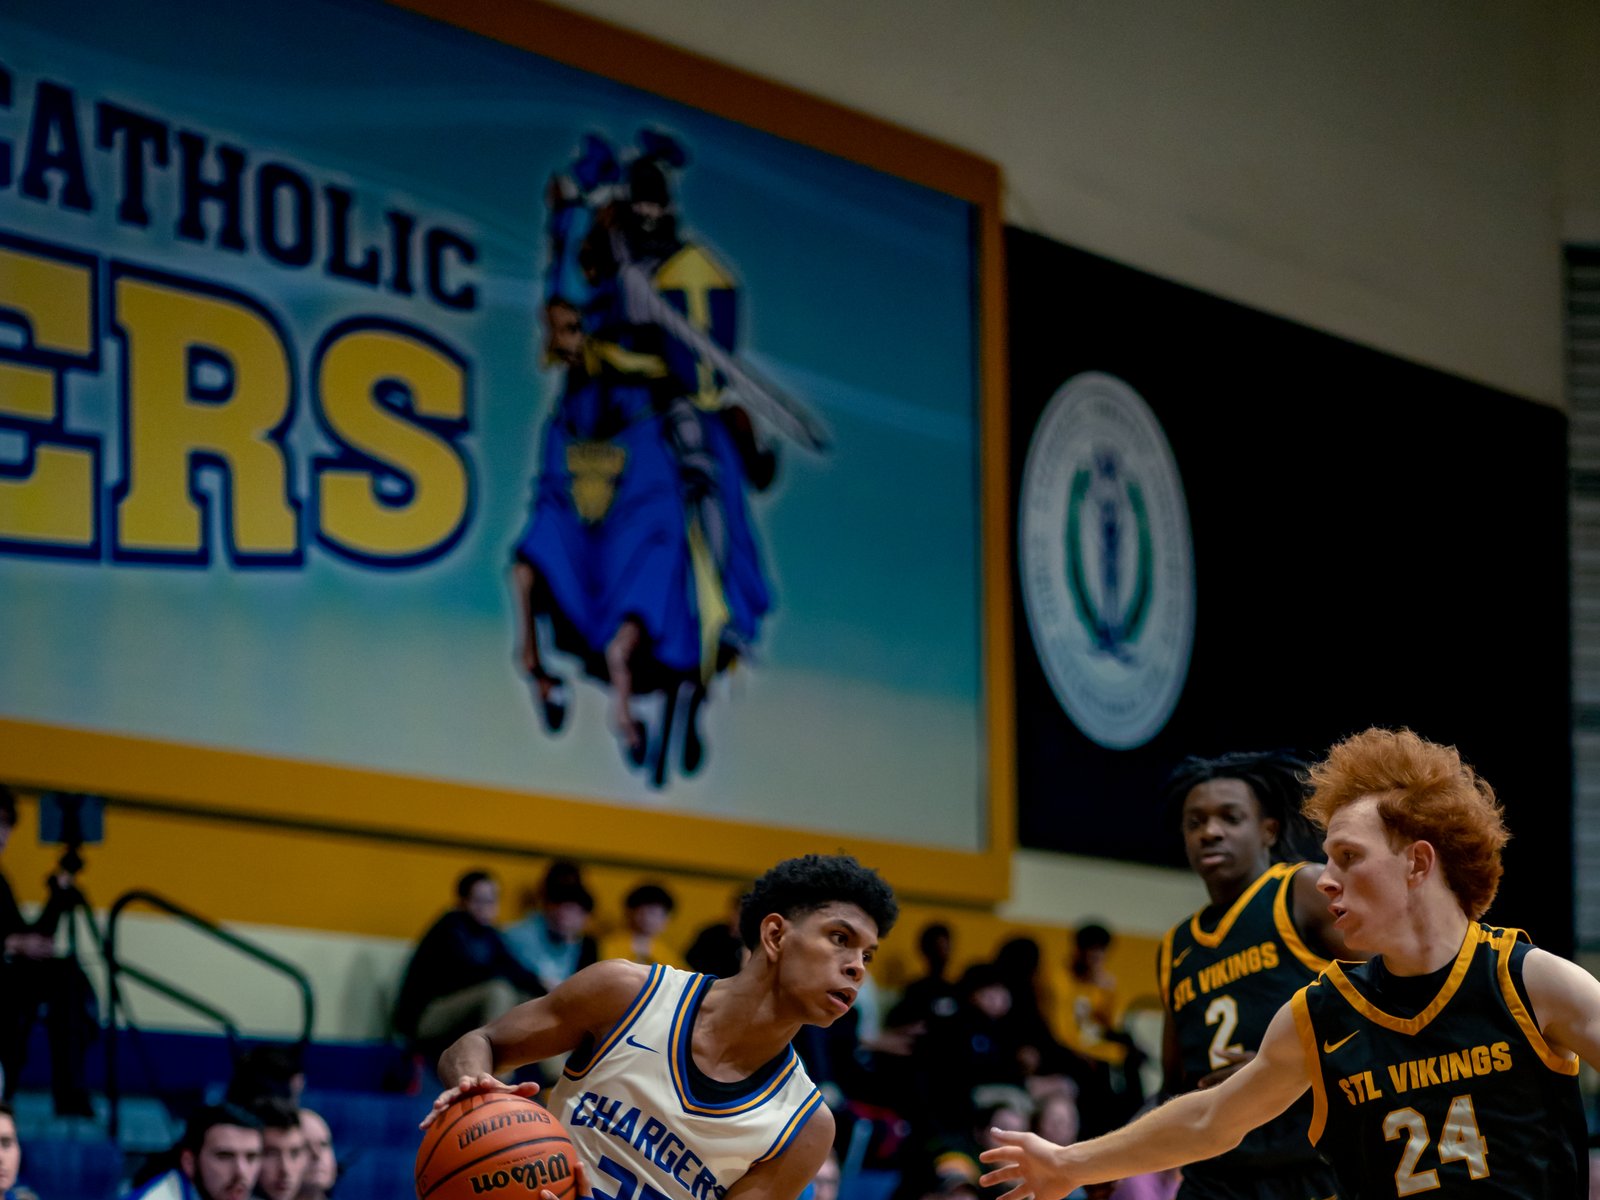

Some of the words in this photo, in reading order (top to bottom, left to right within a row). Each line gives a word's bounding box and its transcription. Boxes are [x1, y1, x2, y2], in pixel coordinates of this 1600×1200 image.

[0, 65, 478, 311] ATHOLIC
[1198, 941, 1279, 994] VIKINGS
[1205, 994, 1244, 1070] 2
[1338, 1070, 1383, 1106] STL
[1387, 1041, 1513, 1094] VIKINGS
[457, 1110, 551, 1149] EVOLUTION
[1382, 1094, 1491, 1198] 24
[470, 1152, 569, 1194] Wilson
